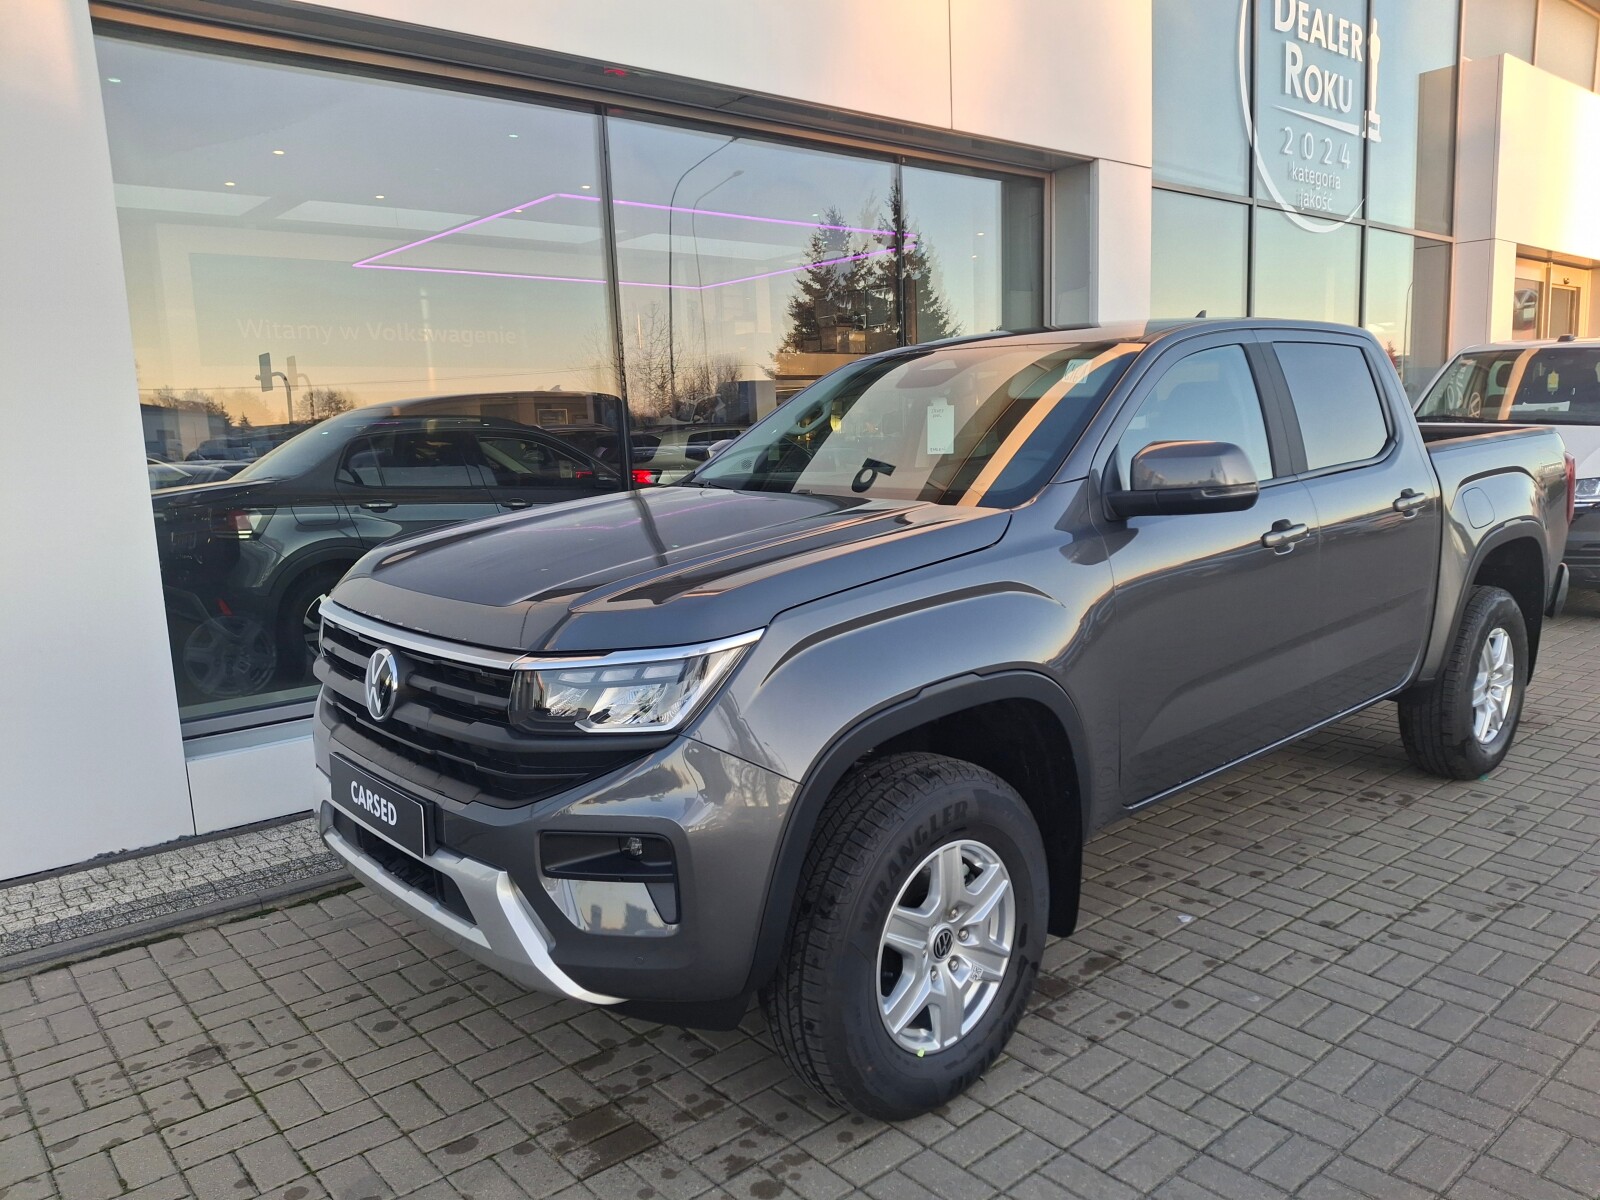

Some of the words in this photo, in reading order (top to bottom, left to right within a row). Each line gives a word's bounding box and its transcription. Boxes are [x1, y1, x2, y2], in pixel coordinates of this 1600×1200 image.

[1274, 0, 1363, 61] DEALER
[1285, 40, 1353, 113] ROKU
[1281, 126, 1351, 169] 2024
[1291, 161, 1341, 189] kategoria
[1299, 187, 1333, 211] jakość
[236, 318, 332, 344] Witamy
[340, 325, 359, 341] w
[366, 322, 517, 347] Volkswagenie
[350, 780, 397, 826] CARSED
